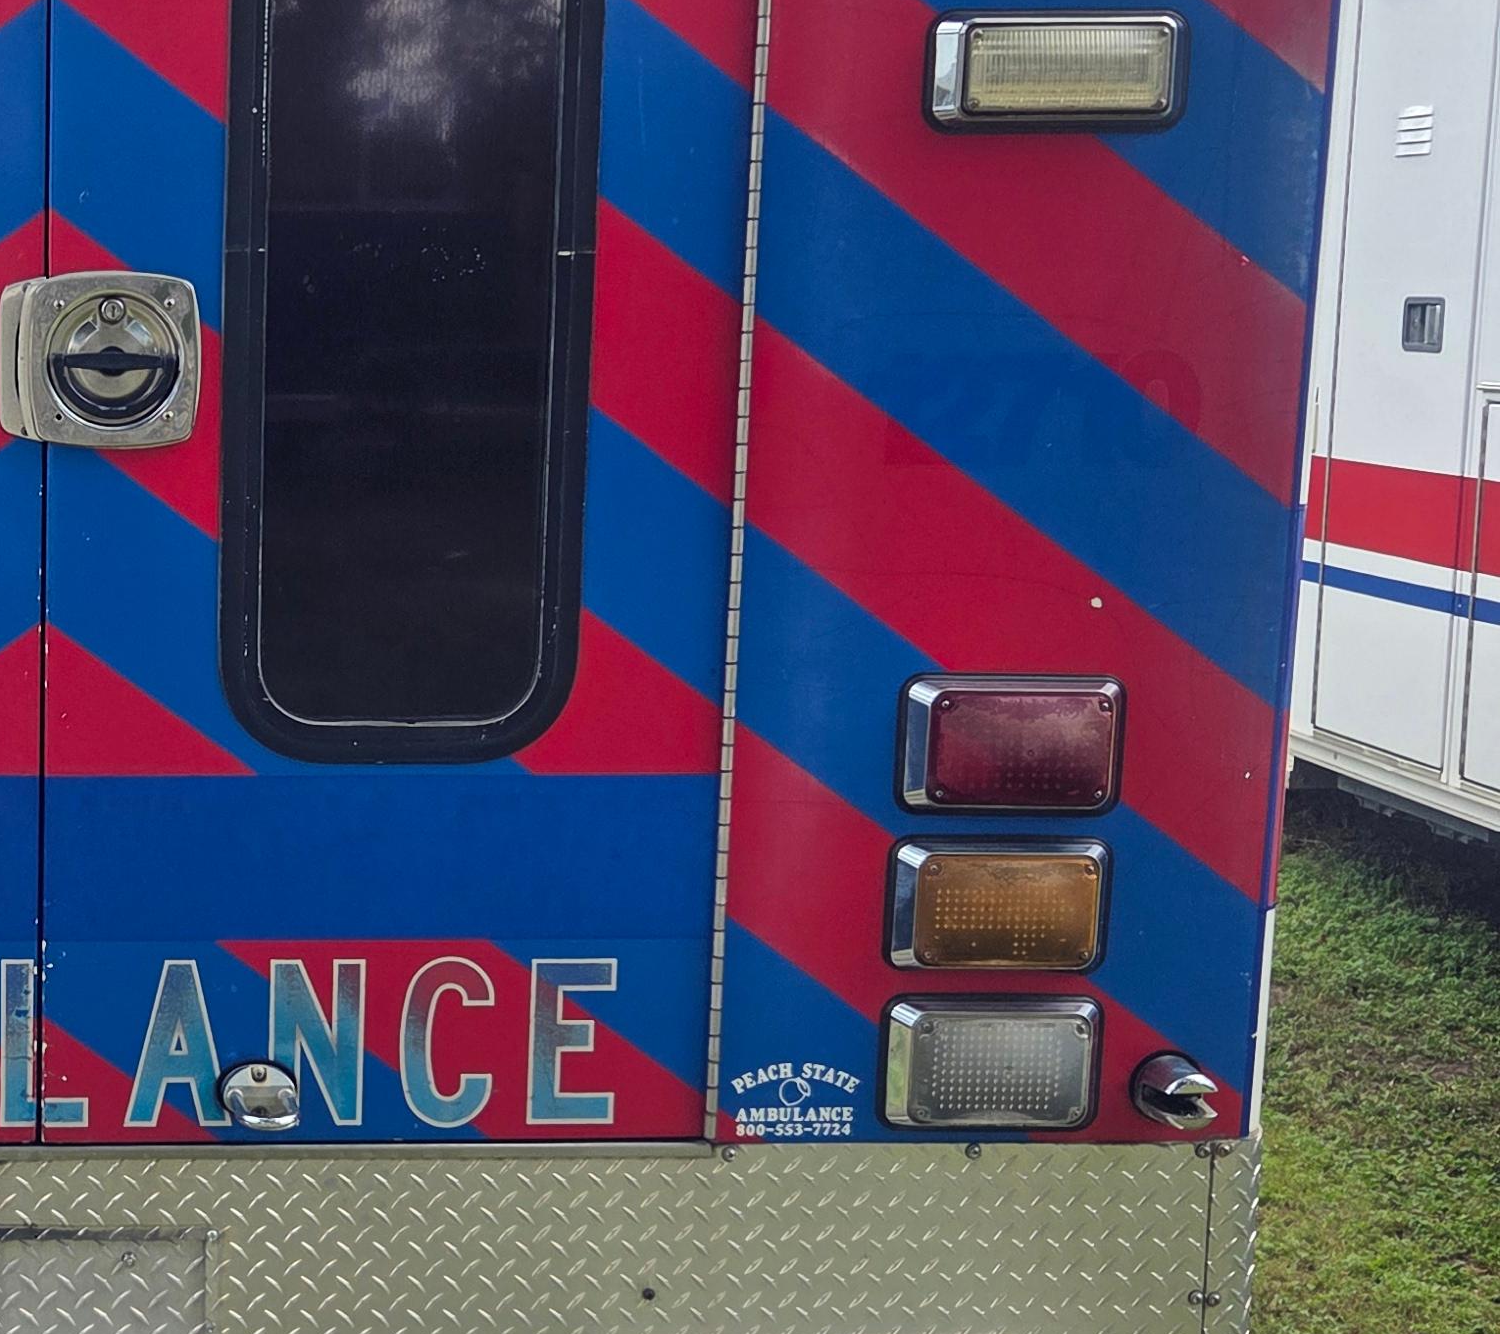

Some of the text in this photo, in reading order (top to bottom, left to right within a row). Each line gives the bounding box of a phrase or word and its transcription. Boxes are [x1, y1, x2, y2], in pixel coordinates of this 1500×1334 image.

[730, 1062, 861, 1094] PEACH STATE
[735, 1107, 853, 1122] AMBULANCE
[736, 1123, 851, 1136] 800-553-7724
